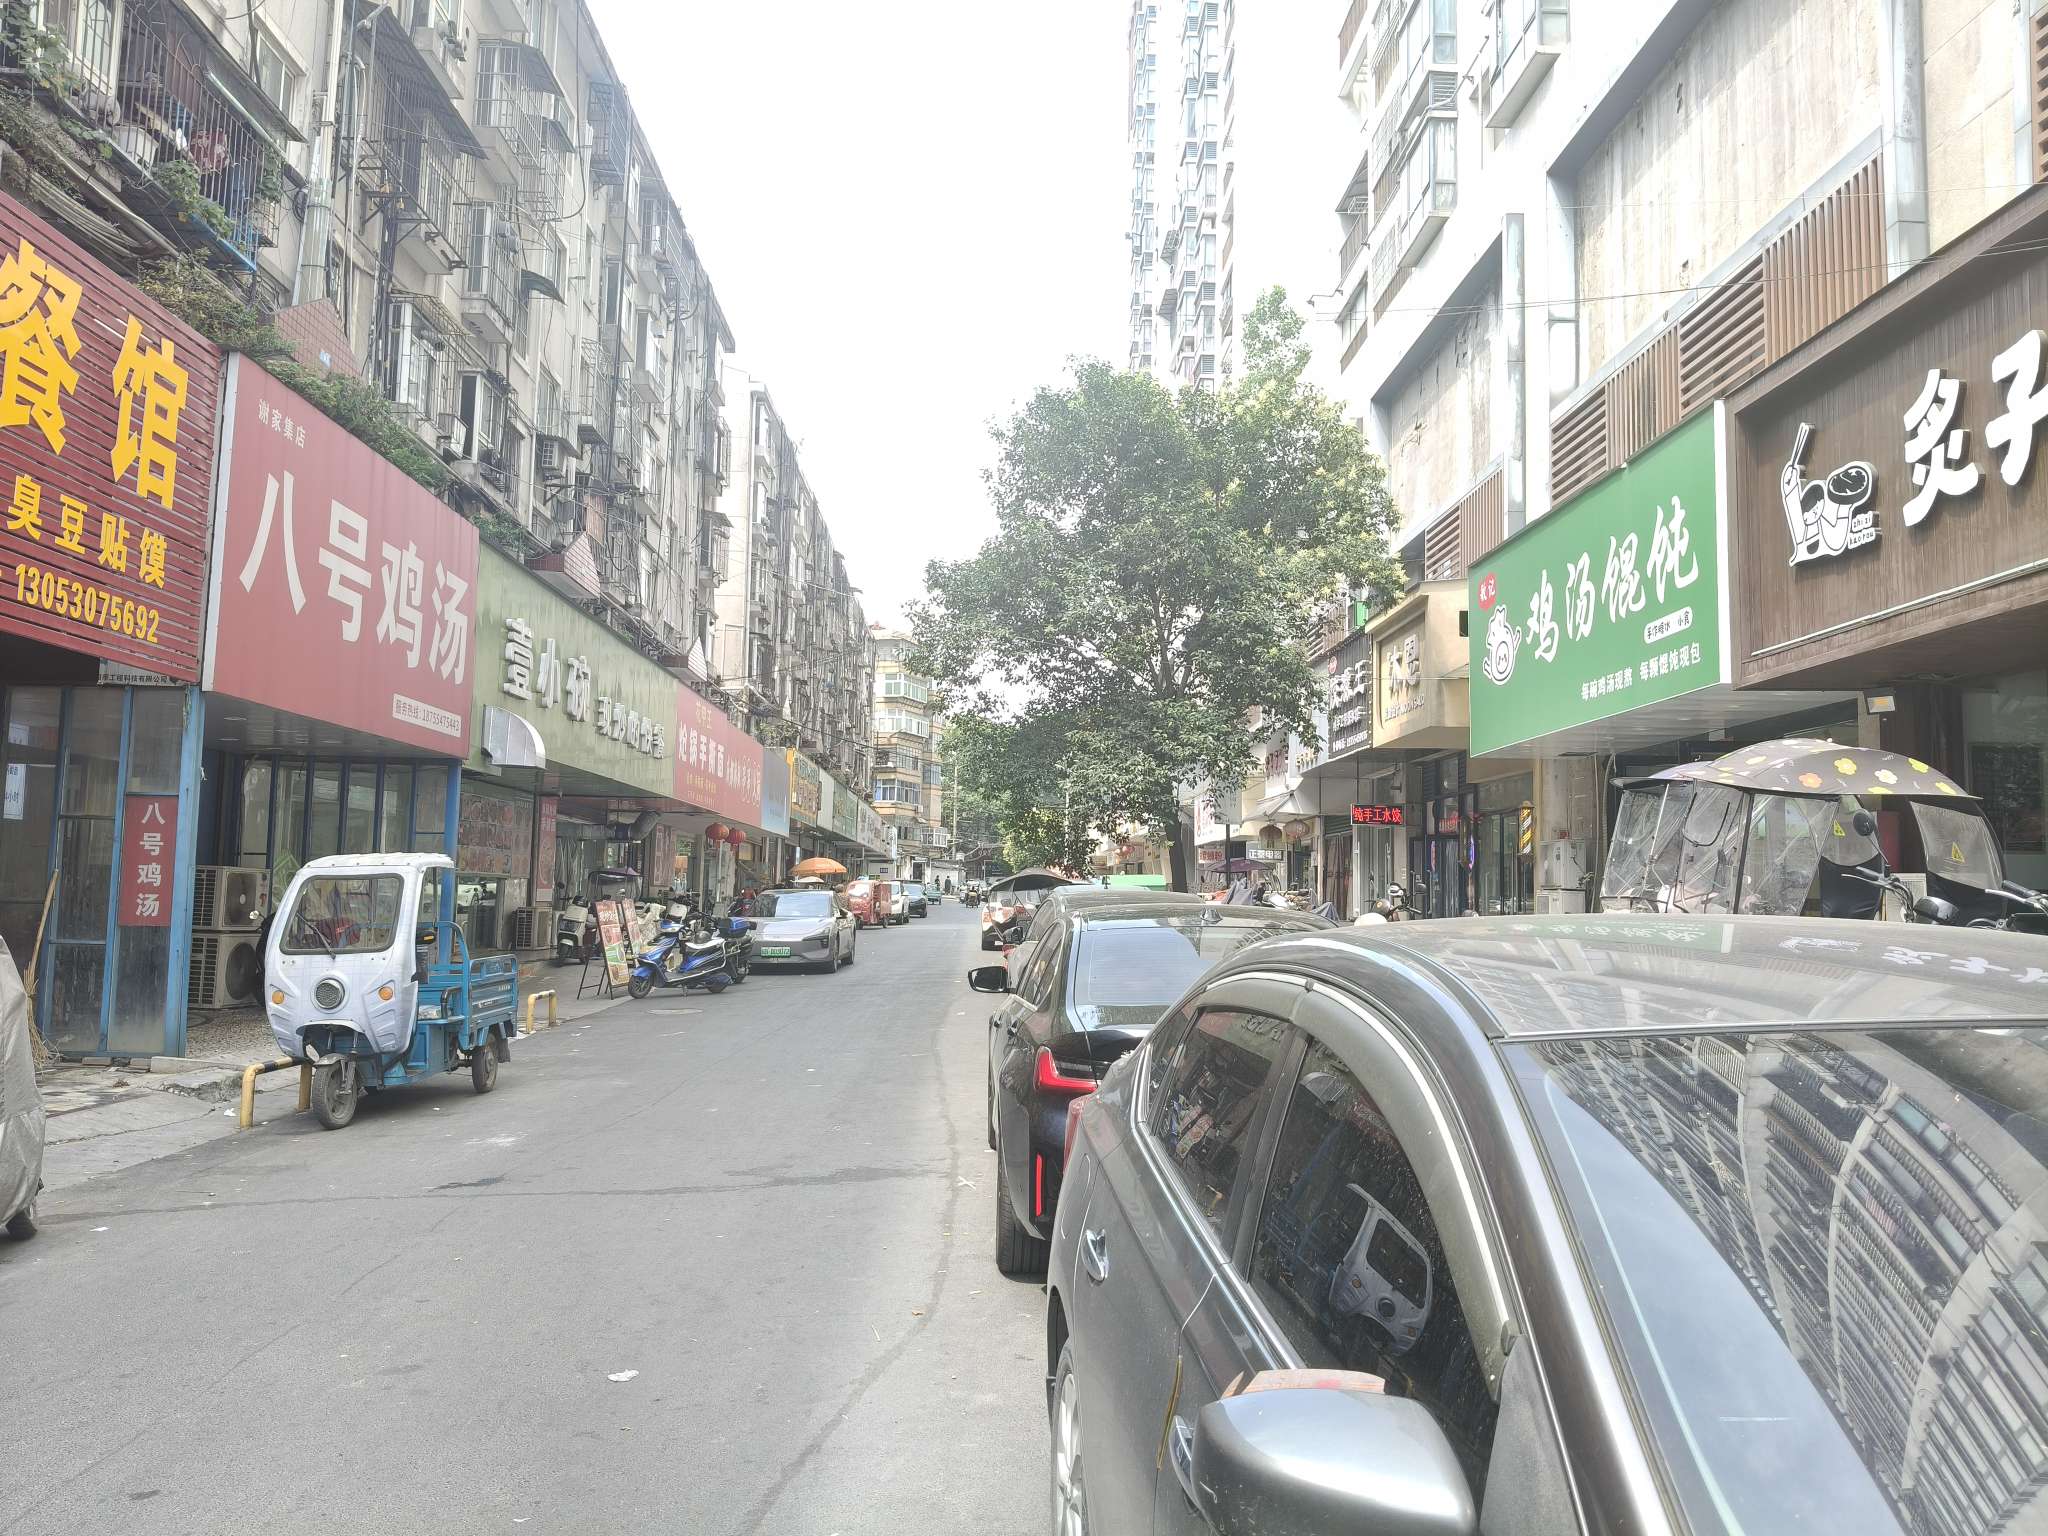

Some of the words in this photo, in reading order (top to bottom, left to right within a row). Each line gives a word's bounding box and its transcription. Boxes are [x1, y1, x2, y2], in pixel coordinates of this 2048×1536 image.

[0, 238, 189, 510] 餐馆
[258, 398, 307, 449] 谢家集店
[1903, 329, 2048, 527] 炙子
[8, 475, 166, 590] 臭豆贴馍
[239, 470, 468, 682] 八号鸡汤
[1525, 495, 1699, 663] 鸡汤馄饨
[15, 563, 160, 645] 13053075692
[1639, 643, 1701, 681] 每颗馄饨现包
[135, 802, 166, 917] 八号鸡汤
[1353, 807, 1402, 823] 纯手工水饺
